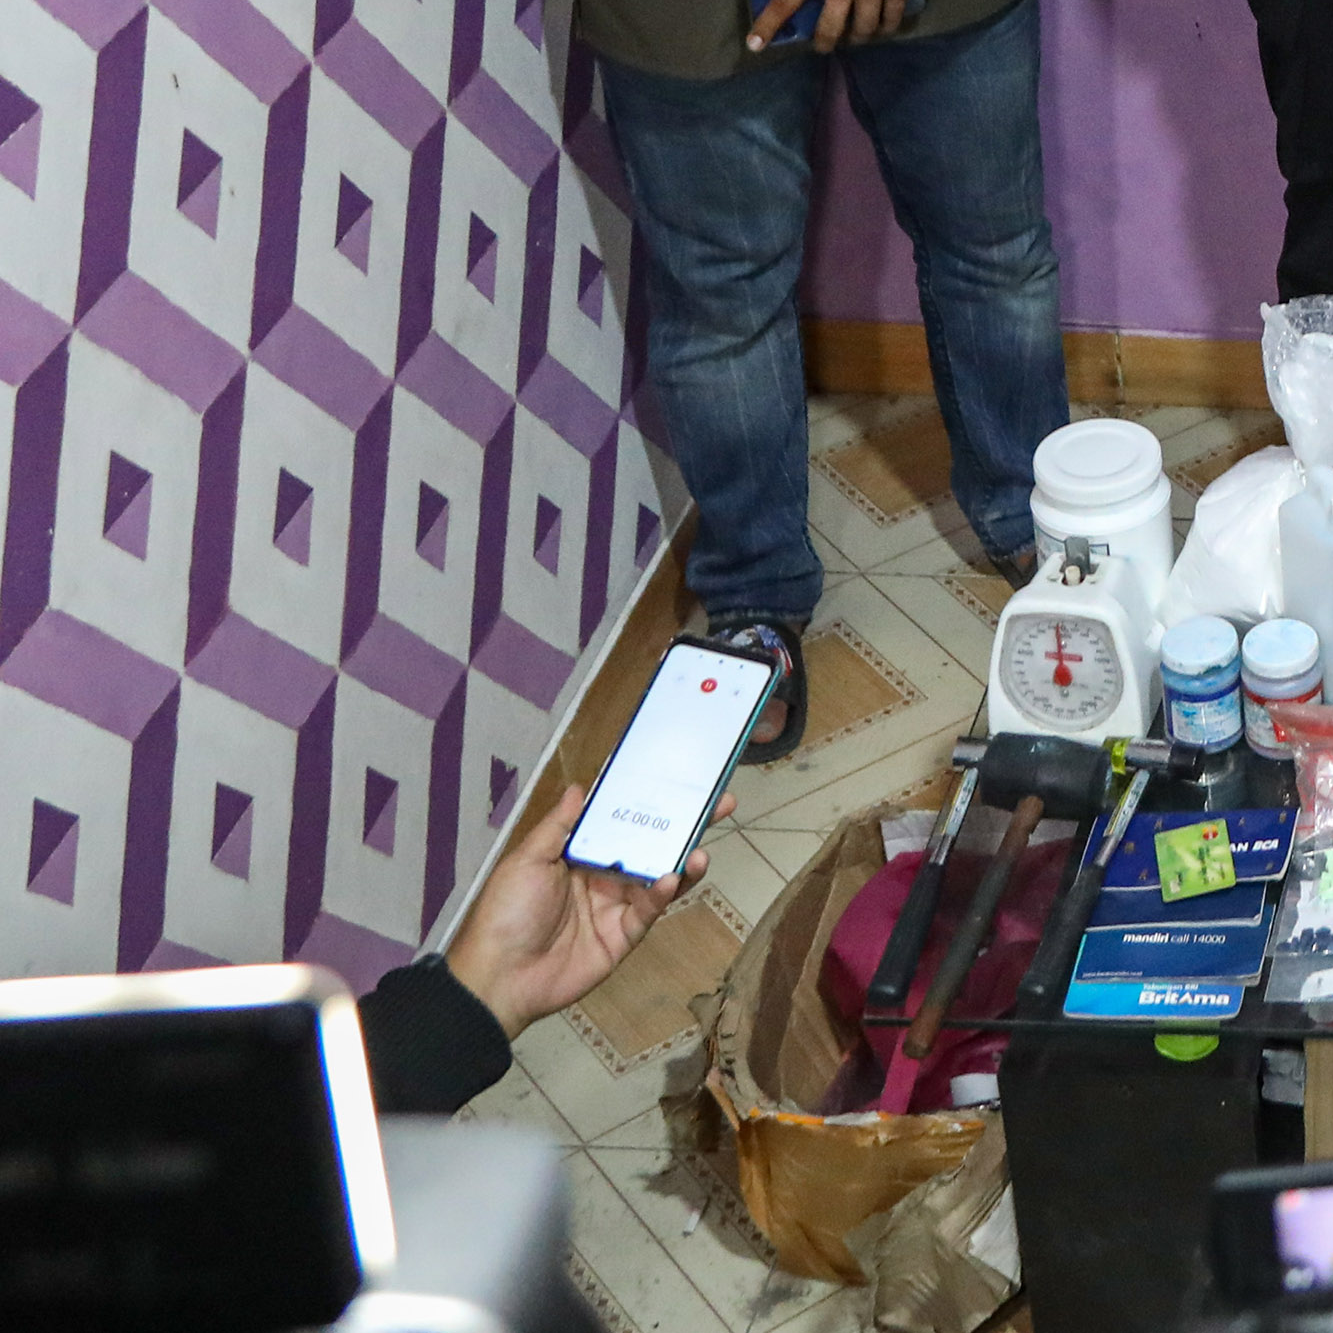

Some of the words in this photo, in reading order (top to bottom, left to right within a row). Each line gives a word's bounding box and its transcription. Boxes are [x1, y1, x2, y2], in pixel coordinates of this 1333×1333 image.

[1252, 838, 1279, 852] BCA
[1122, 932, 1170, 944] mandiri
[1170, 933, 1189, 944] call
[1193, 933, 1226, 945] 14000
